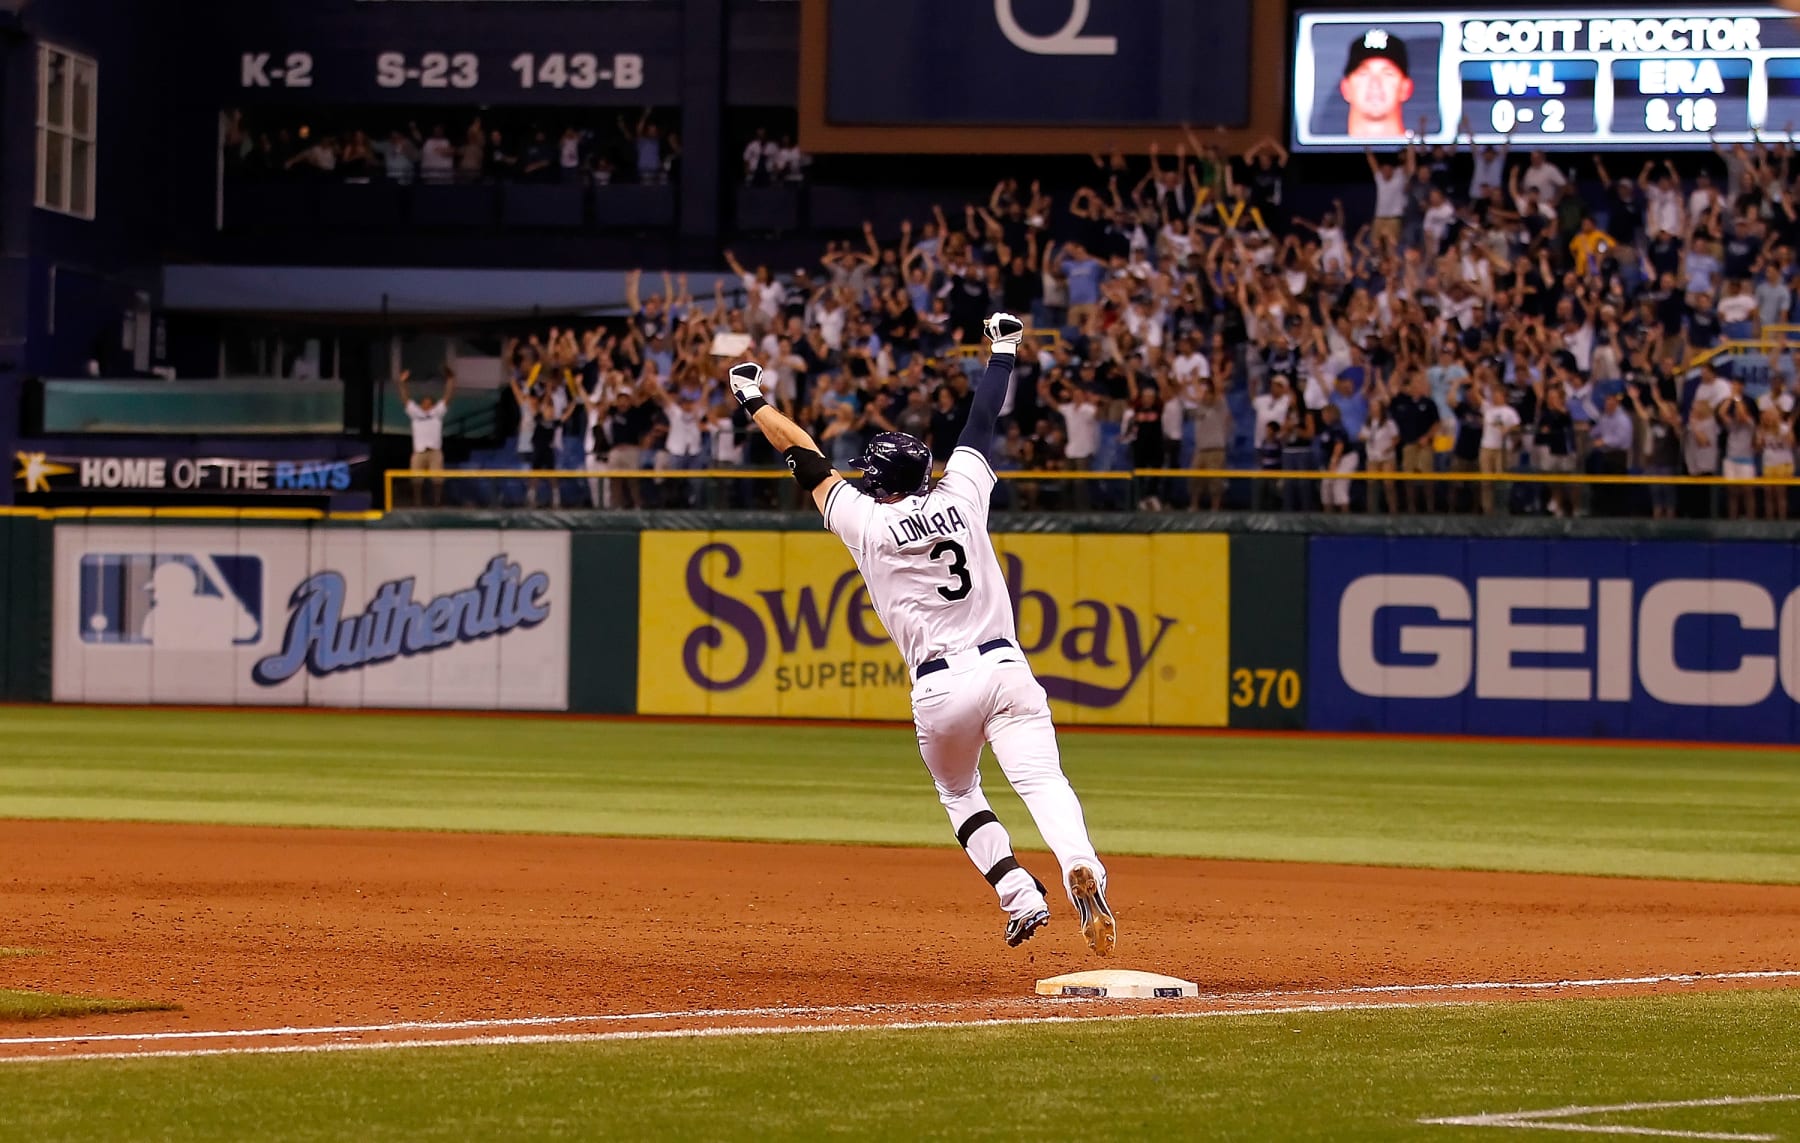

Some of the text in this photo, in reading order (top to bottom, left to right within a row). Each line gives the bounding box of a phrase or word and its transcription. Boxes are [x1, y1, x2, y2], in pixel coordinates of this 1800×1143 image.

[1462, 18, 1761, 53] SCOTT PROCTOR
[241, 52, 313, 87] K-2
[376, 52, 479, 88] S-23
[510, 53, 644, 89] 143-B
[1490, 61, 1565, 95] W-L
[1639, 59, 1725, 94] ERA
[80, 458, 352, 490] HOME OF THE RAYS
[929, 538, 974, 603] 3
[252, 552, 551, 687] Authentic
[682, 542, 1178, 708] Swebay
[1338, 573, 1800, 707] GEIC
[775, 660, 907, 693] SUPERM
[1232, 667, 1301, 709] 370
